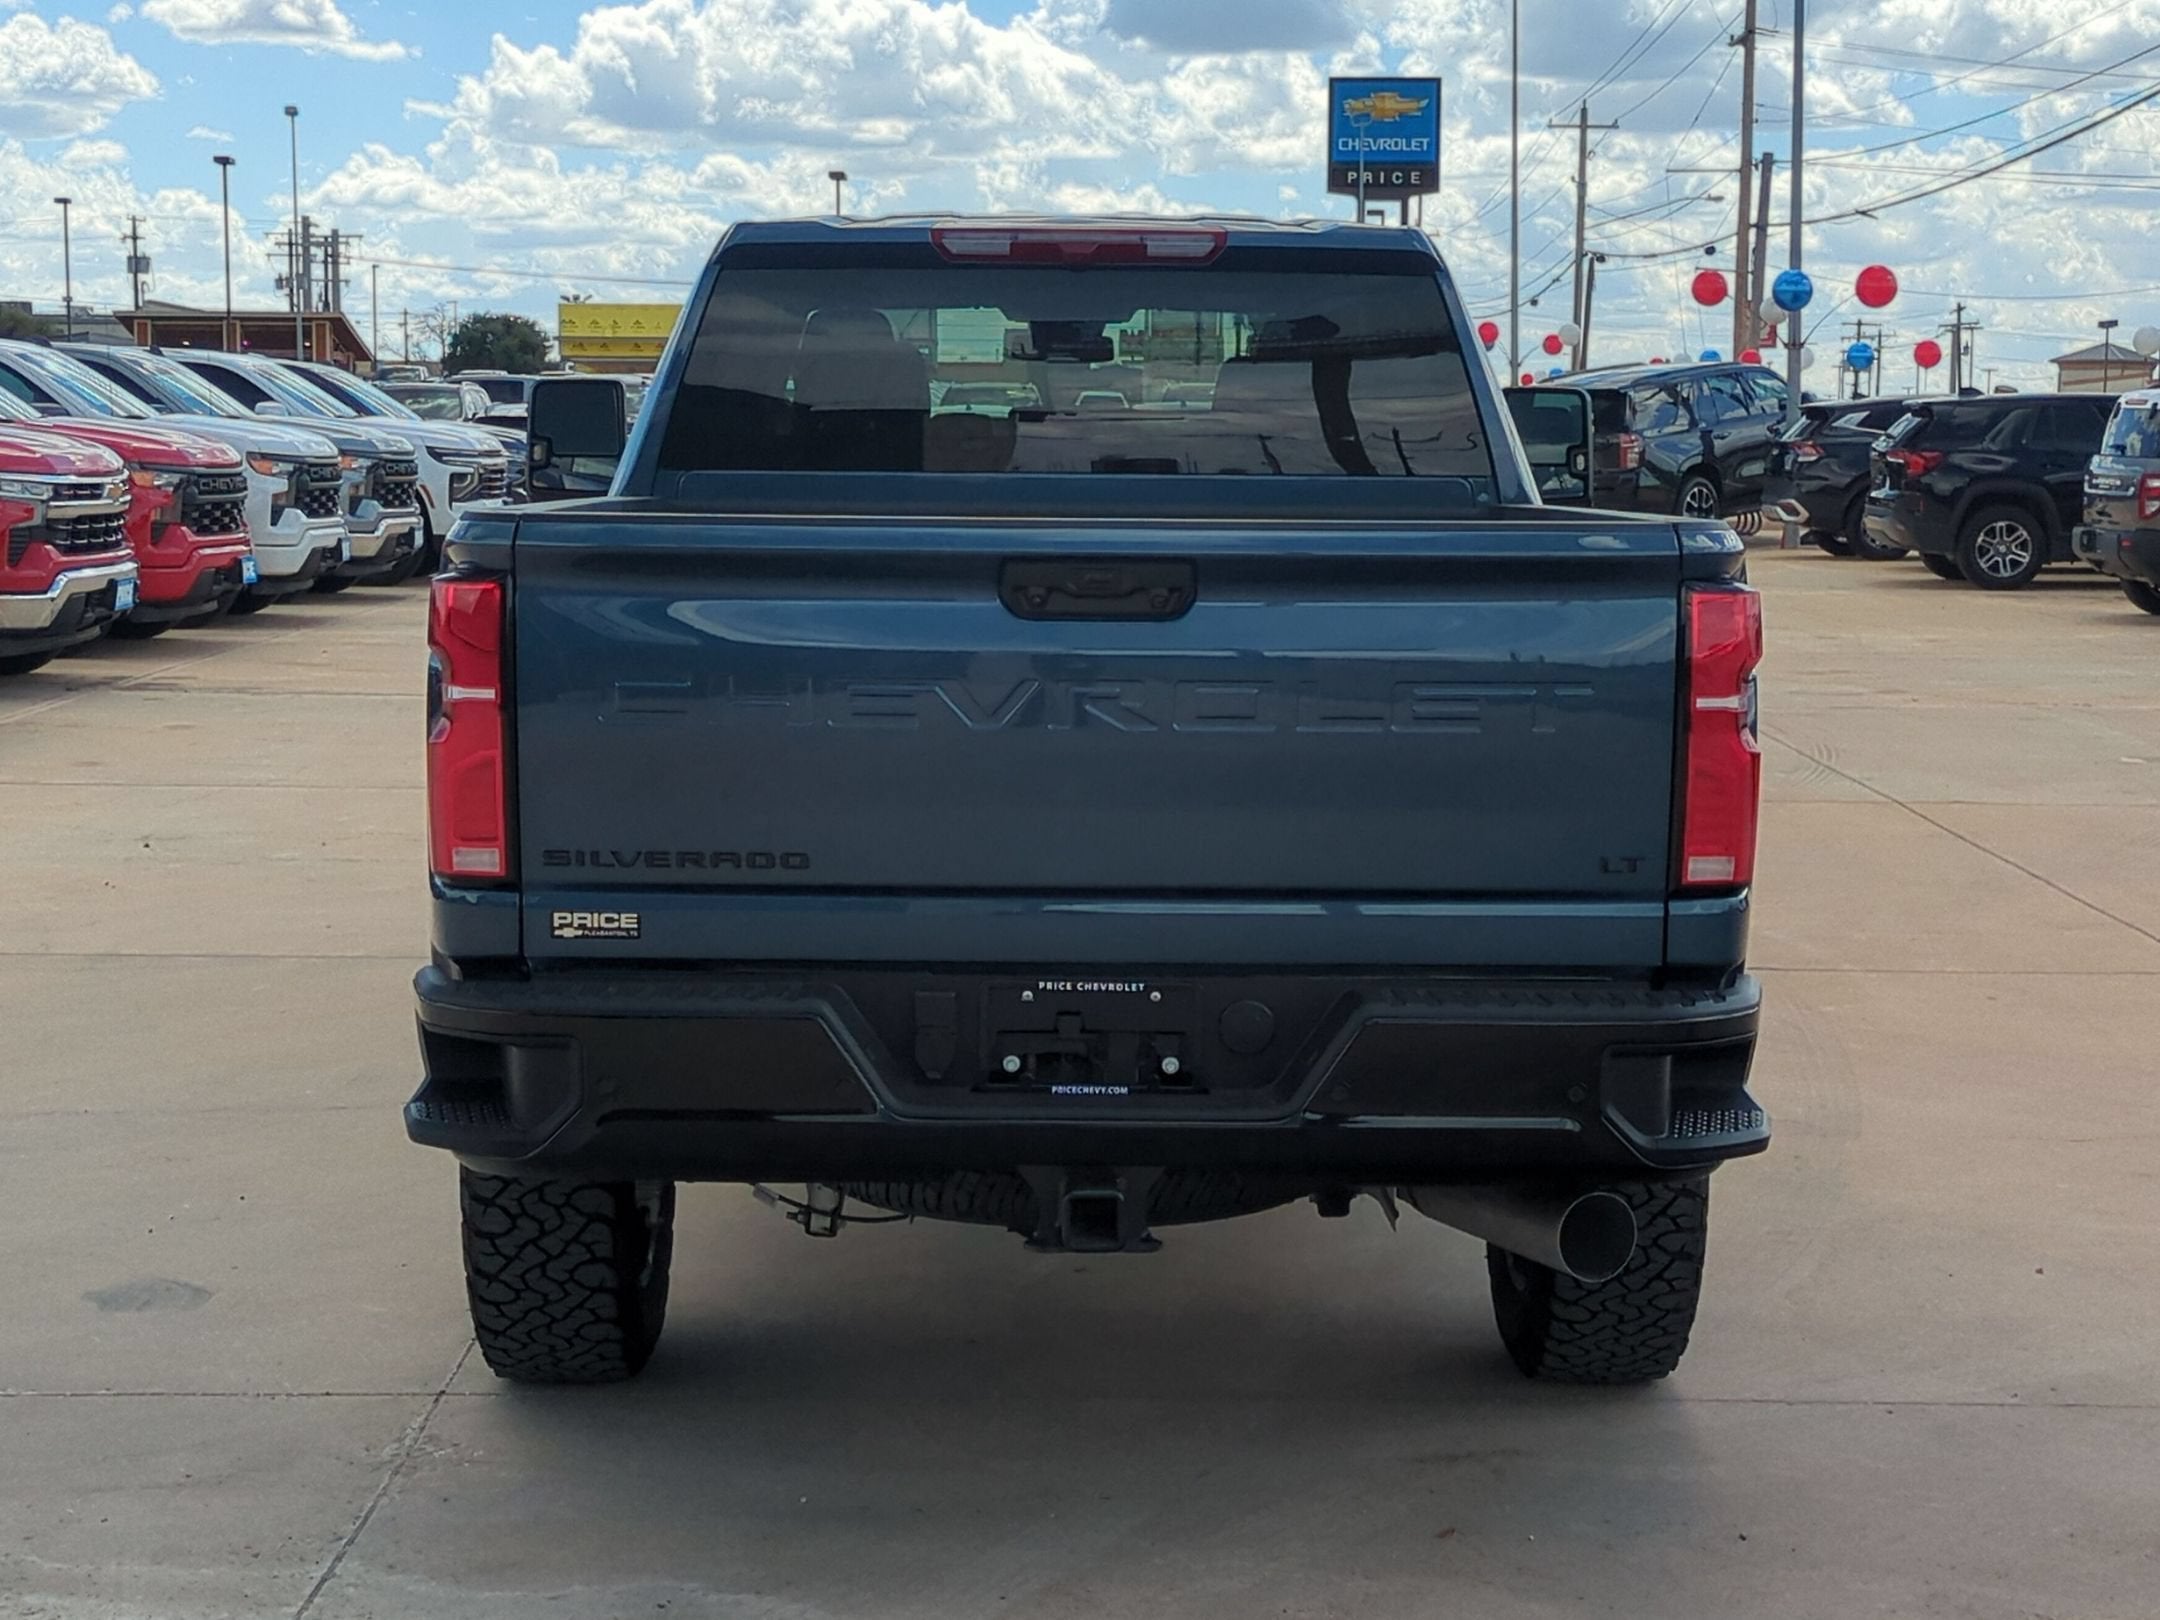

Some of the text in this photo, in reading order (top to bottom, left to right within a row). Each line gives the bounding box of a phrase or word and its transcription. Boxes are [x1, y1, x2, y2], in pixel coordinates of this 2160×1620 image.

[1338, 137, 1430, 151] CHEVROLET
[1347, 171, 1422, 184] PRICE
[597, 677, 1597, 733] CHEVROLET
[542, 849, 810, 870] SILVERADO
[1600, 856, 1646, 873] LT
[553, 912, 638, 928] PRICE
[1038, 981, 1145, 992] PRICE CHEVROLET
[1051, 1085, 1129, 1095] PRICECHEVY.COM
